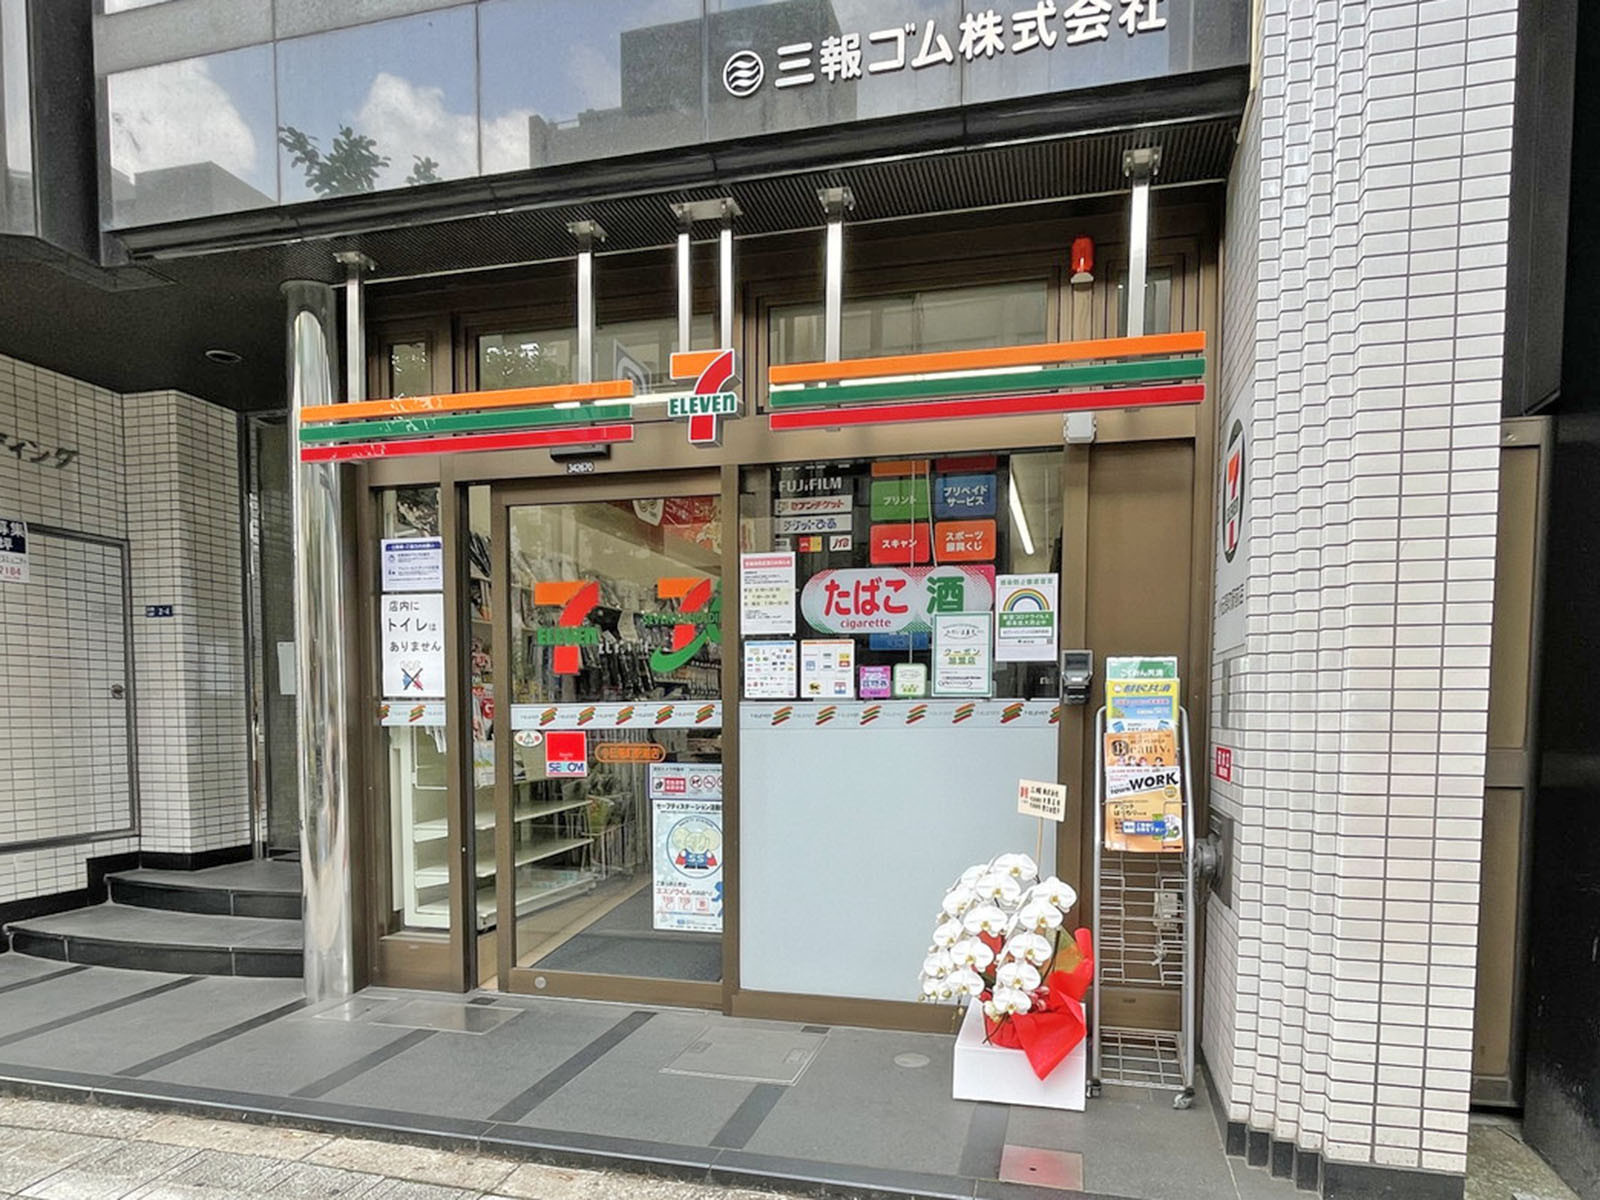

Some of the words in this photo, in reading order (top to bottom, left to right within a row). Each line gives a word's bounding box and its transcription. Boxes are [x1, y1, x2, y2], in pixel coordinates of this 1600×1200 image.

[775, 0, 1167, 88] 三報ゴム株式会社
[778, 477, 842, 493] FUJIFILM
[943, 485, 988, 497] プリペイド
[883, 496, 917, 506] プリント
[946, 496, 985, 507] サービス
[945, 531, 984, 542] スポーツ
[882, 539, 918, 549] スキャン
[824, 576, 909, 616] たばこ
[926, 576, 964, 614] 酒
[388, 600, 420, 613] 店内に
[388, 617, 437, 632] トイレは
[840, 618, 892, 630] cigarette
[389, 640, 442, 653] ありません
[1129, 771, 1179, 791] WORK
